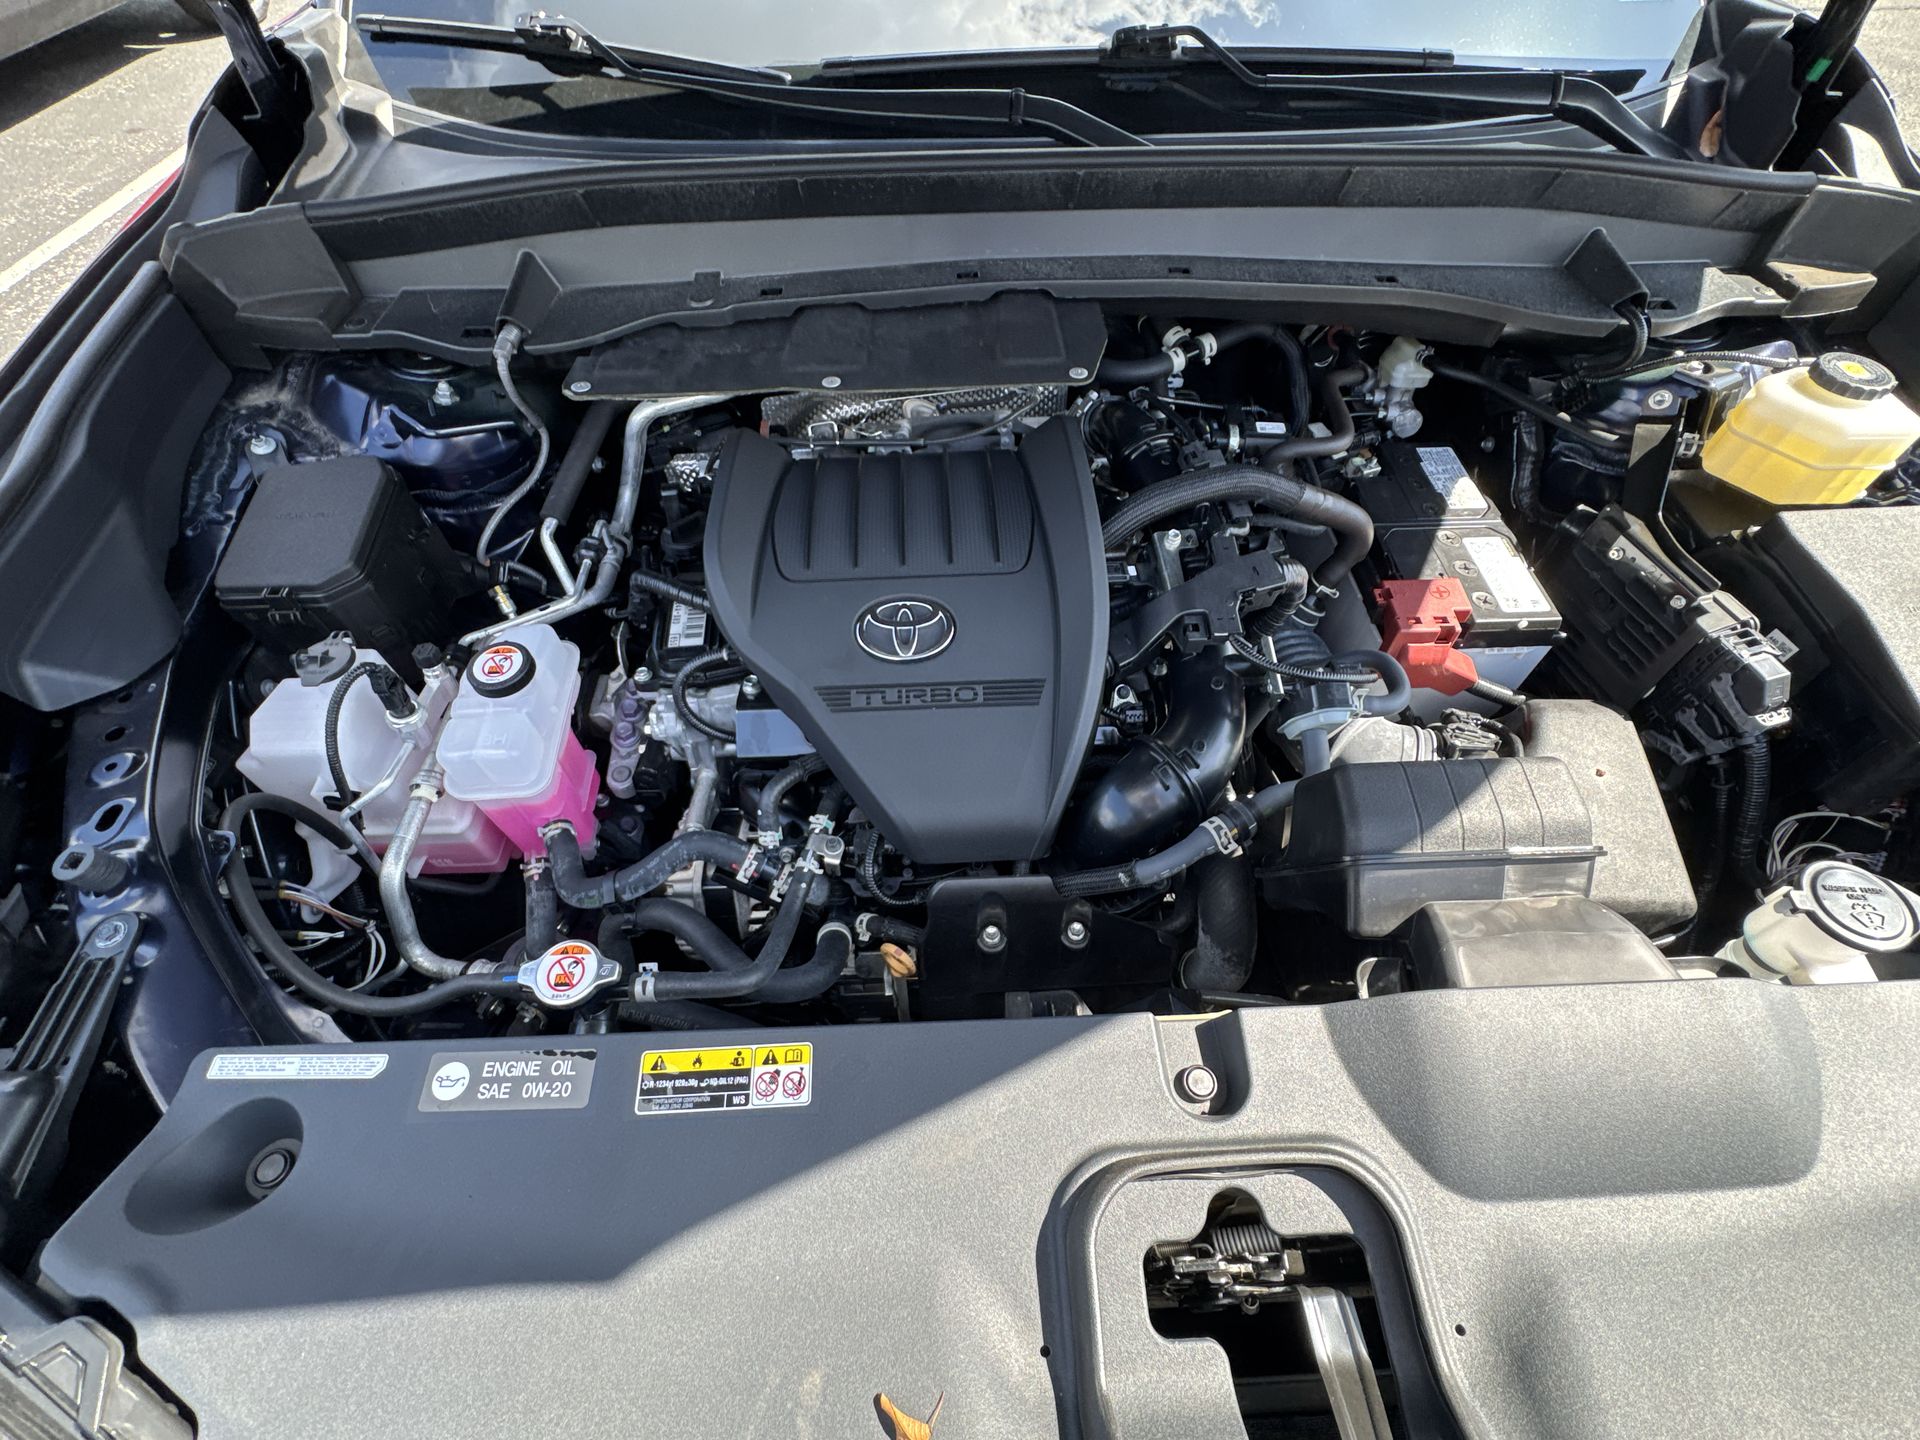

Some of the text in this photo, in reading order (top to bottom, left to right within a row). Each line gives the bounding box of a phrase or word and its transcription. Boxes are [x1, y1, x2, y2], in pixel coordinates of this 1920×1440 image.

[855, 687, 978, 705] TURBO
[482, 1060, 576, 1077] ENGINE OIL
[477, 1082, 571, 1099] SAE 0W-20
[732, 1094, 746, 1105] WS
